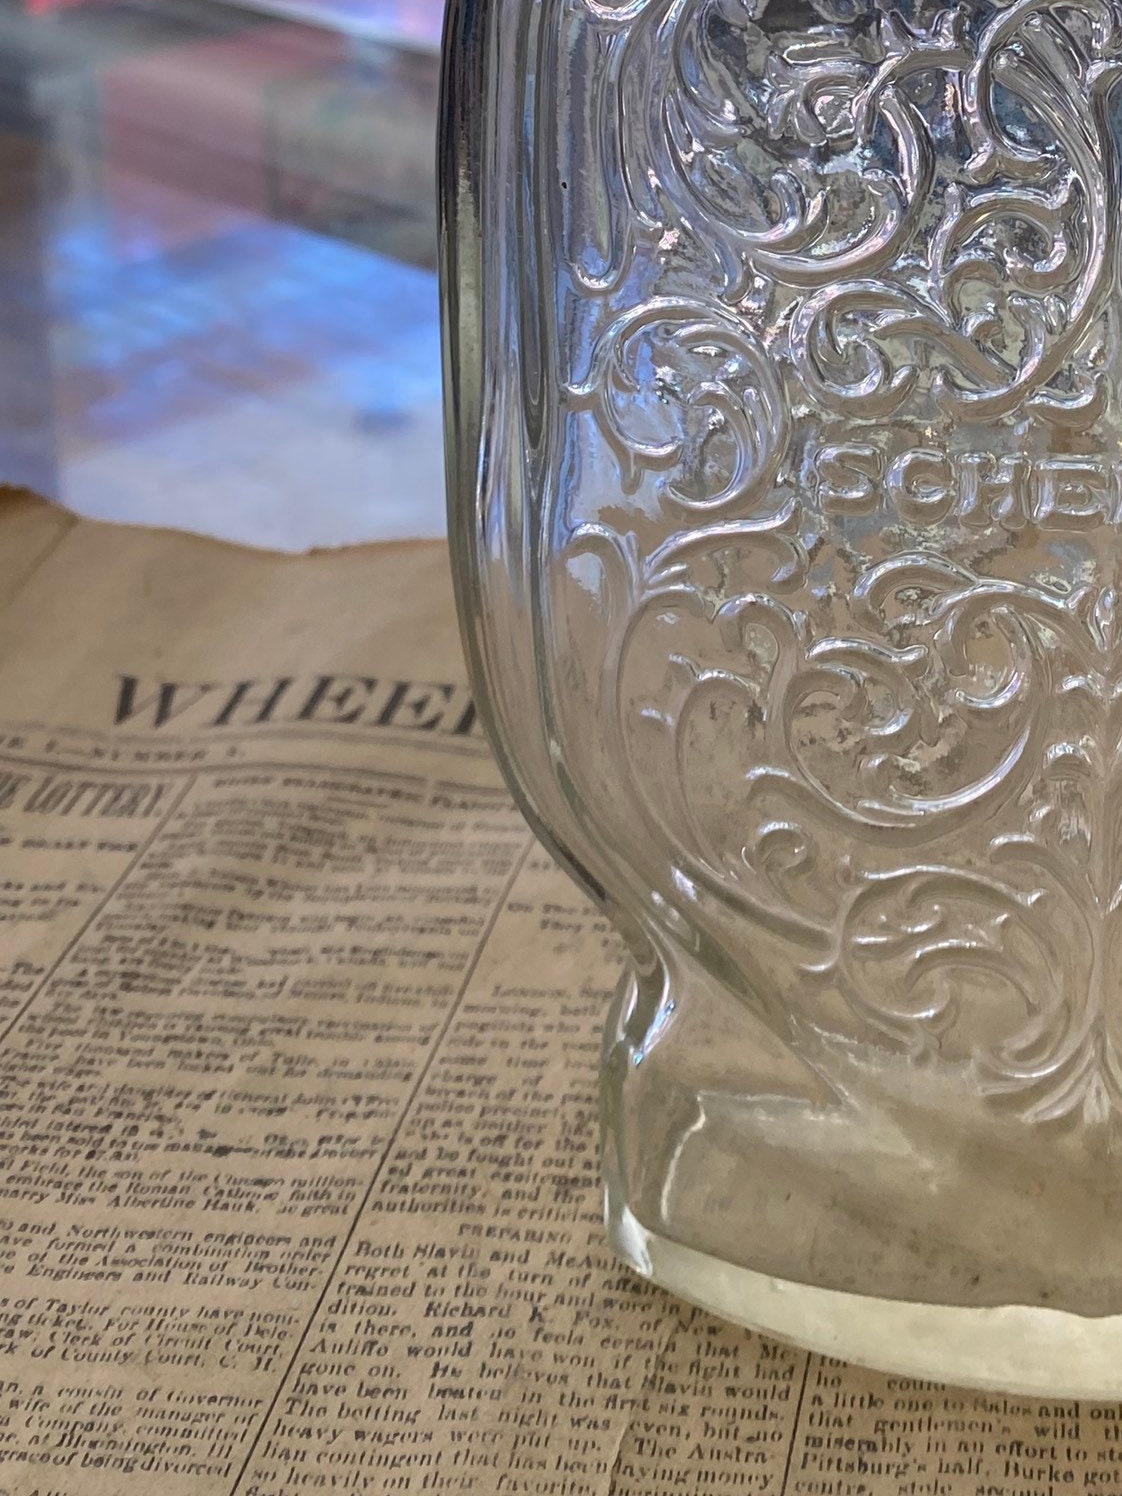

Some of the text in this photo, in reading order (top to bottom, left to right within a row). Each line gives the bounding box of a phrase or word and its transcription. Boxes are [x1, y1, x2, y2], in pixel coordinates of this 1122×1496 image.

[300, 1234, 336, 1249] and
[406, 1341, 473, 1359] would
[552, 1353, 596, 1369] won
[284, 1397, 328, 1418] The
[337, 1401, 422, 1426] betting
[498, 1408, 558, 1427] night
[569, 1414, 611, 1432] was
[1037, 1402, 1081, 1420] and
[272, 1419, 343, 1445] heavy
[353, 1429, 434, 1446] wagers
[634, 1437, 677, 1459] The
[808, 1410, 854, 1429] that
[1034, 1420, 1082, 1442] wild
[1066, 1446, 1088, 1462] to
[1003, 1461, 1075, 1484] Burke
[1083, 1467, 1121, 1487] got
